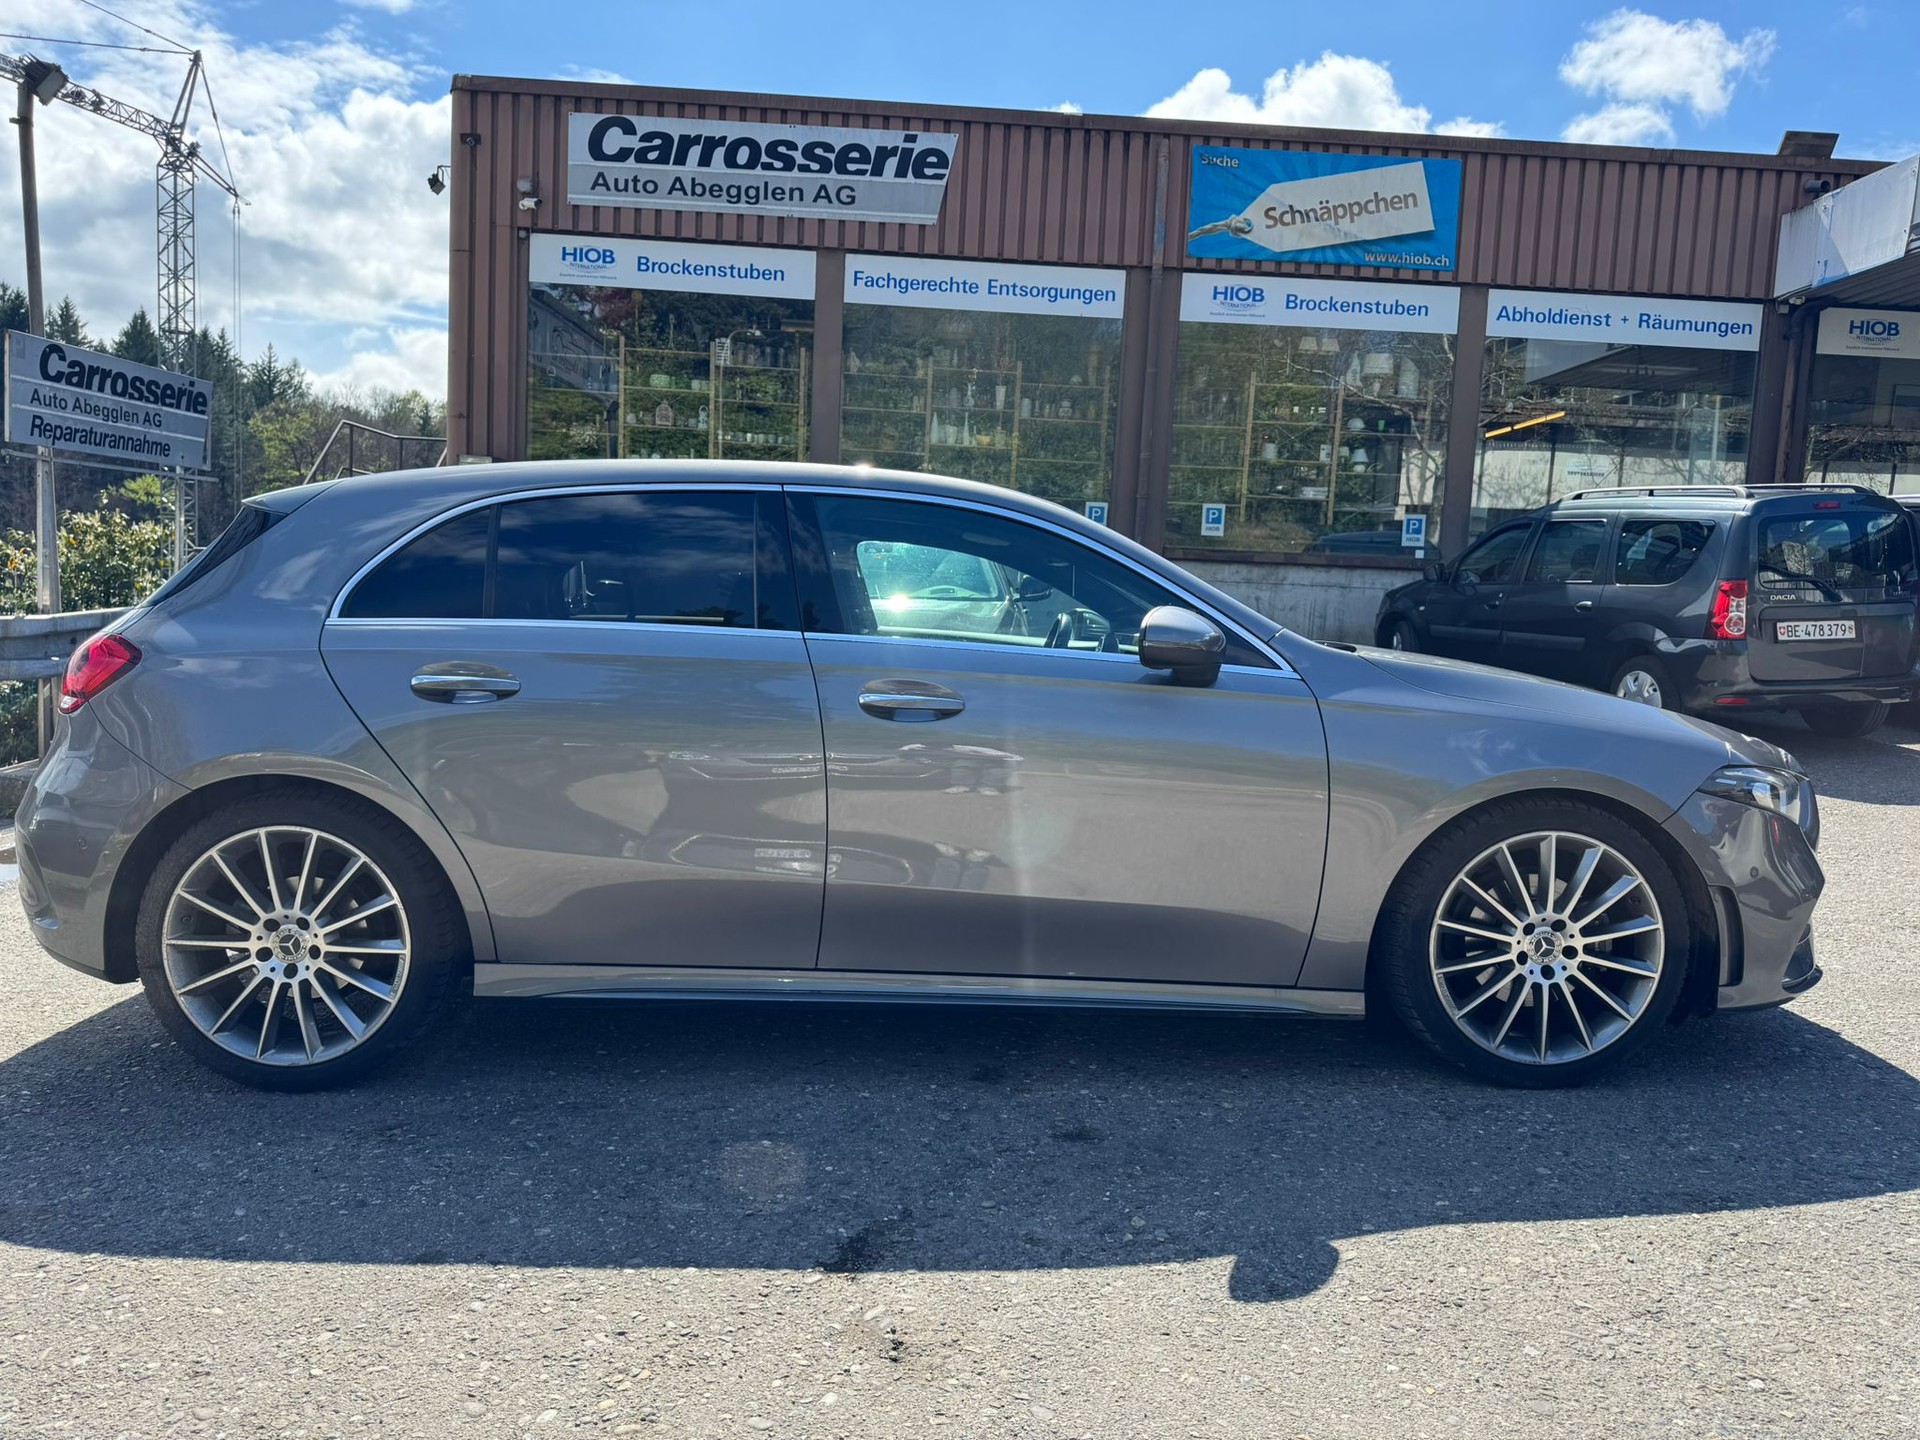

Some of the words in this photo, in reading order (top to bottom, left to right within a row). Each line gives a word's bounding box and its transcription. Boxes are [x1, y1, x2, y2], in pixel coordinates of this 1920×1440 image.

[587, 115, 951, 182] Carrosserie
[1201, 153, 1239, 168] Suche
[589, 171, 659, 195] Auto
[667, 174, 804, 206] Abegglen
[812, 184, 857, 206] AG
[1263, 191, 1419, 230] Schnäppchen
[561, 246, 616, 264] HIOB
[636, 255, 785, 282] Brockenstuben
[1364, 251, 1450, 267] www.hiob.ch
[853, 270, 980, 295] Fachgerechte
[987, 278, 1116, 305] Entsorgungen
[1212, 285, 1265, 303] HIOB
[1285, 293, 1429, 317] Brockenstuben
[1495, 305, 1612, 327] Abholdienst
[1638, 312, 1753, 338] Räumungen
[1848, 319, 1900, 337] HIOB
[39, 343, 209, 416] Carrosserie
[30, 387, 68, 411] Auto
[72, 396, 140, 424] Abegglen
[142, 411, 163, 428] AG
[30, 414, 171, 458] Reparaturannahme
[1209, 509, 1219, 523] P
[1409, 520, 1419, 534] P
